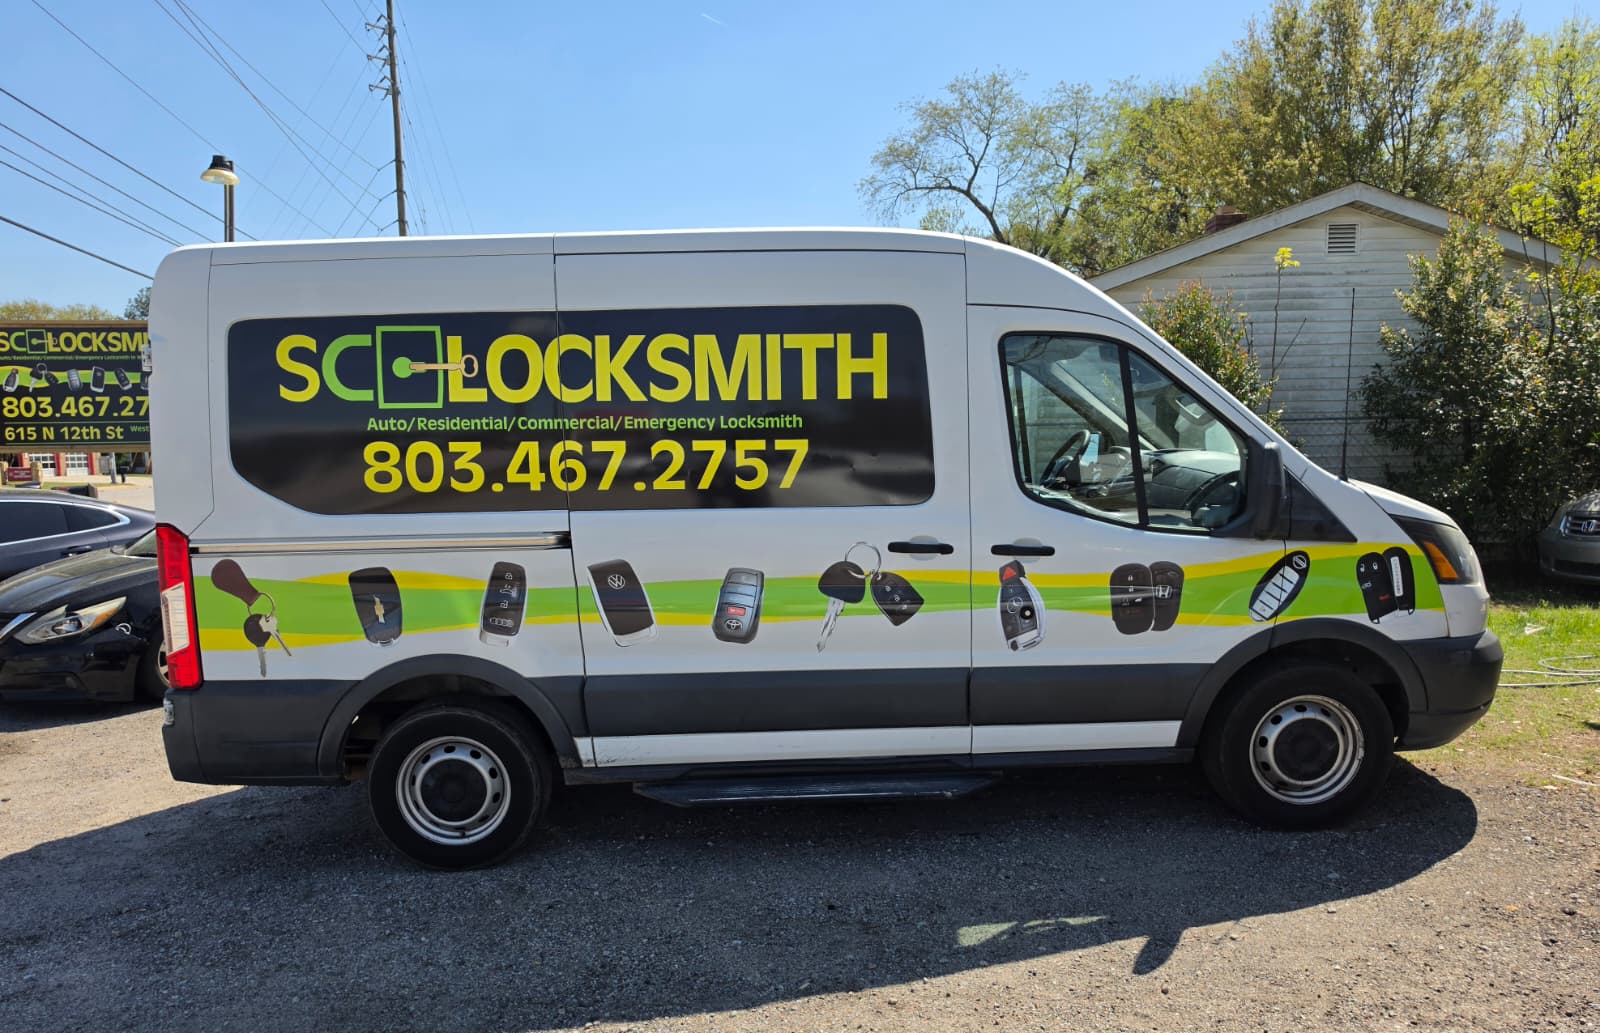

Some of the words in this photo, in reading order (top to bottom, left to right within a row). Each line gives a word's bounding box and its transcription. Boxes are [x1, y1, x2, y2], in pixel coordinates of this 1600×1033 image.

[275, 335, 375, 403] SC
[446, 332, 889, 404] LOCKSMITH
[4, 426, 37, 441] 615
[42, 426, 55, 440] N
[60, 426, 101, 441] 12th
[105, 426, 124, 440] St
[366, 415, 716, 433] Auto/Residential/Commercial/Emergency
[719, 414, 804, 430] Locksmith
[362, 438, 809, 494] 803.467.2757
